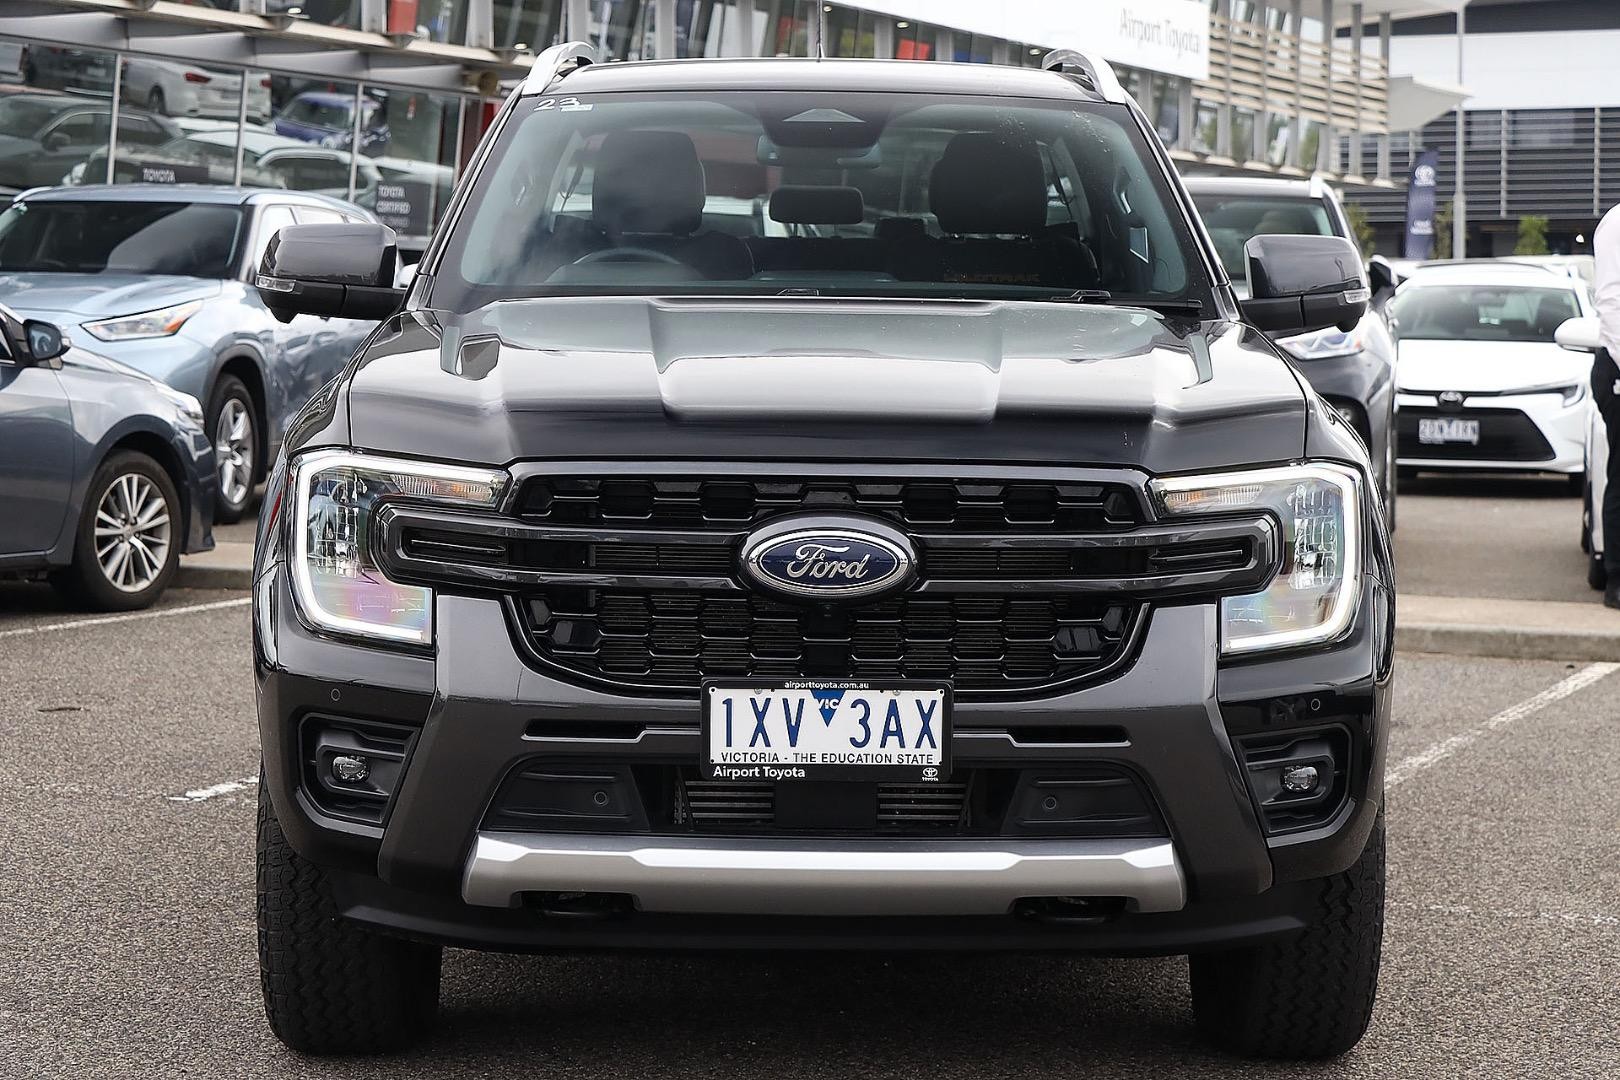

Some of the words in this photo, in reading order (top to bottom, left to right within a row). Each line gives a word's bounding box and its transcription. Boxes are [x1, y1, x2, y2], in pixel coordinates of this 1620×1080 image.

[1119, 7, 1161, 49] Airport
[1164, 18, 1200, 58] Toyota
[786, 543, 871, 579] Ford
[784, 681, 870, 690] airporttoyota.com.au
[816, 698, 840, 709] VIC
[722, 697, 806, 748] 1XV
[849, 698, 938, 749] 3AX
[721, 752, 780, 763] VICTORIA
[793, 752, 817, 763] THE
[821, 752, 892, 763] EDUCATION
[896, 753, 934, 764] STATE
[713, 766, 760, 780] Airport
[762, 766, 806, 780] Toyota
